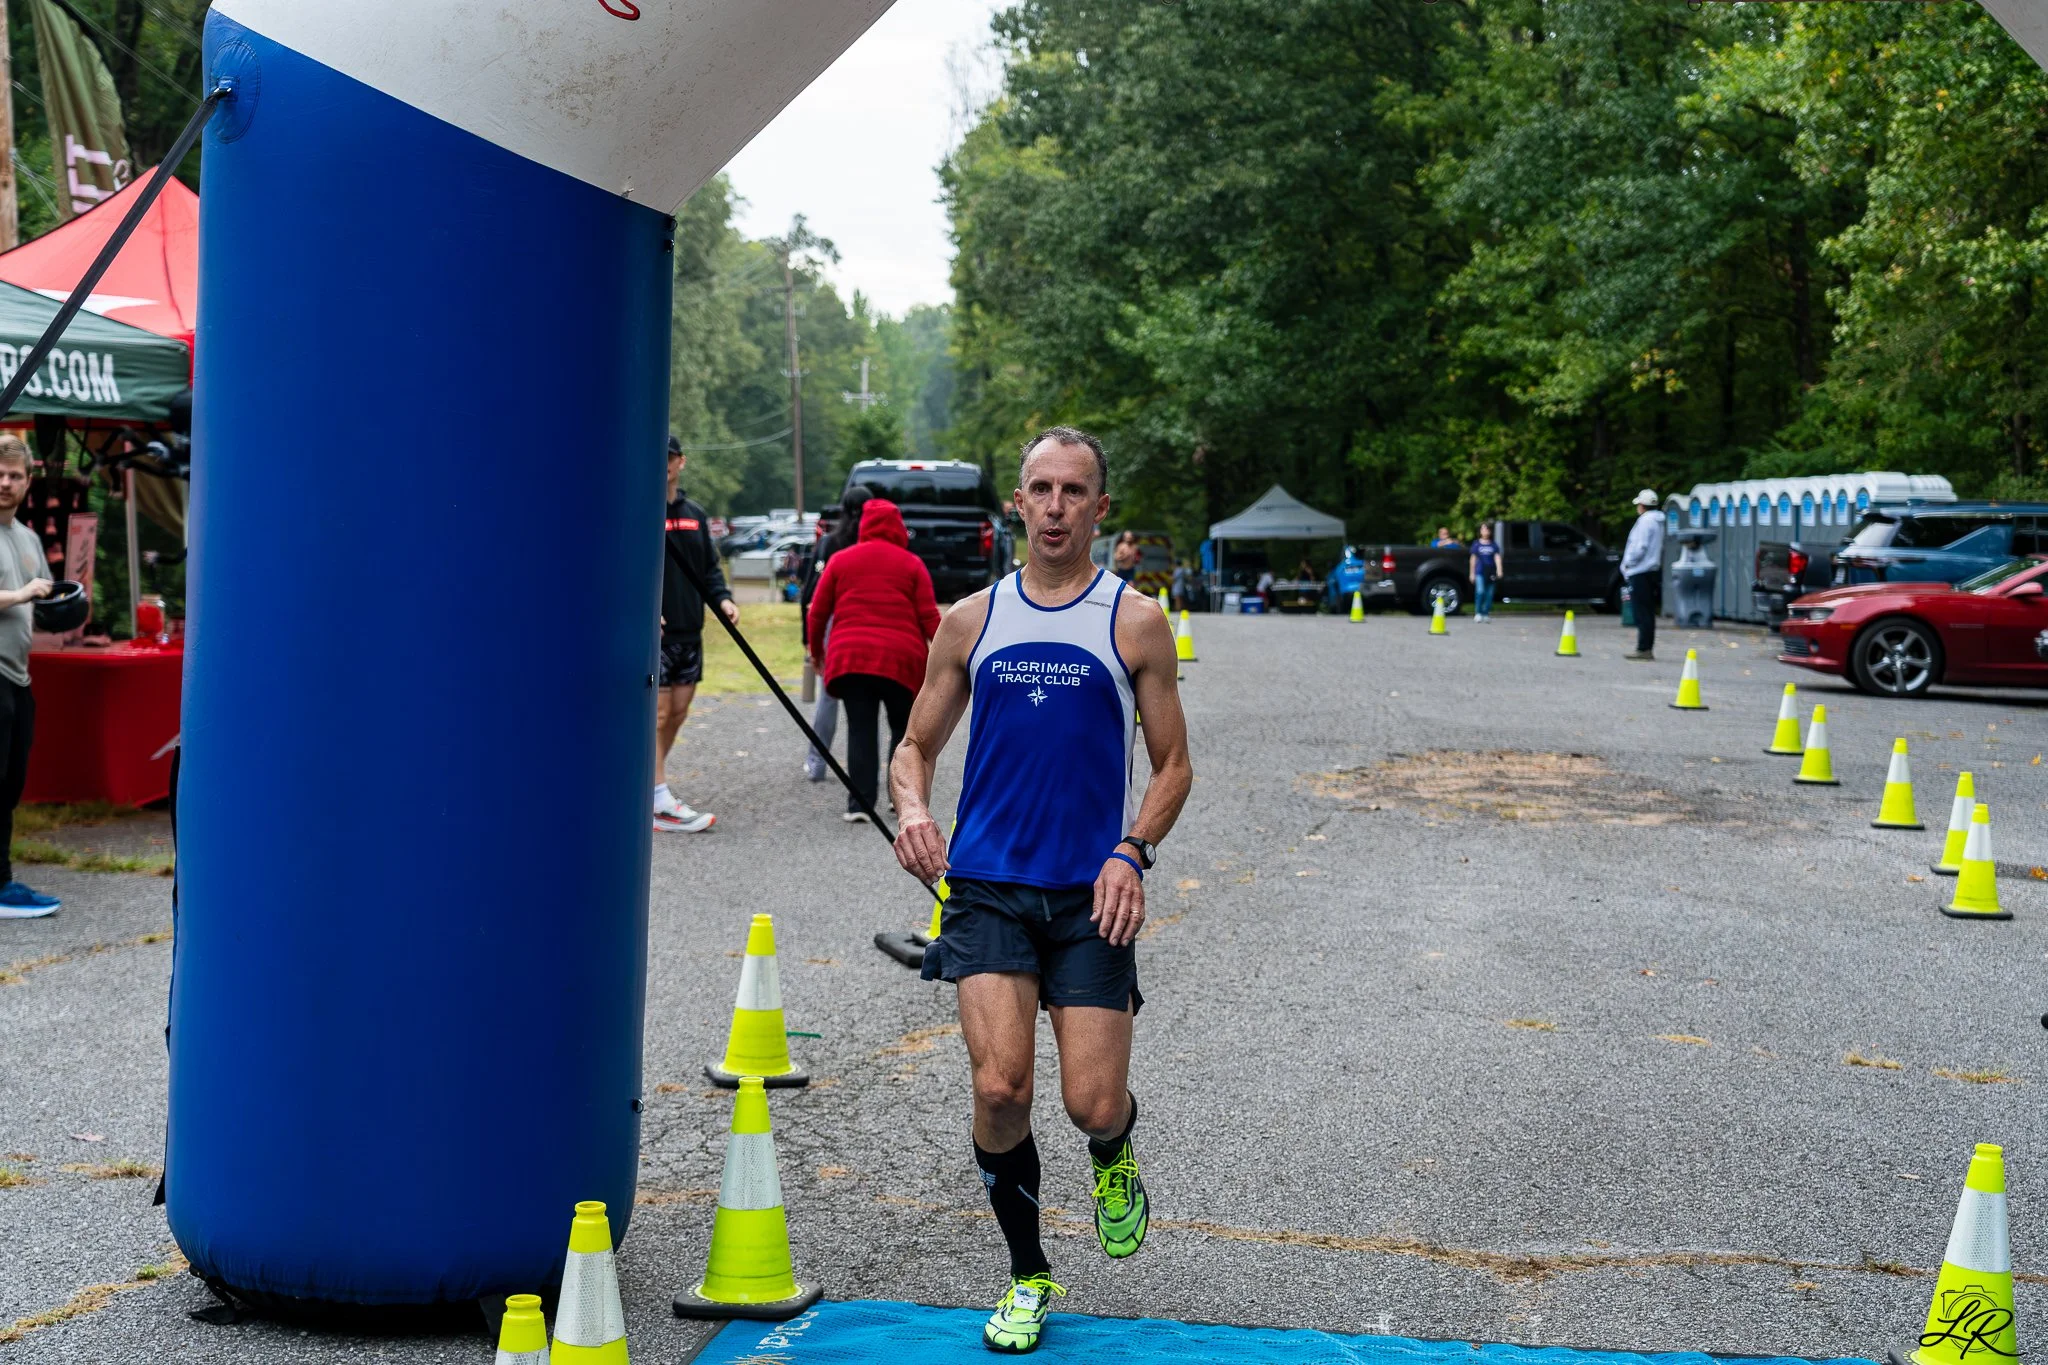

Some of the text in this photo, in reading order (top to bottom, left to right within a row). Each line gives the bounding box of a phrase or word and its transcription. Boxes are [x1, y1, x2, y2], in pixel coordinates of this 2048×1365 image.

[991, 660, 1091, 676] PILGRIMAGE
[997, 673, 1081, 687] TRACK CLUB
